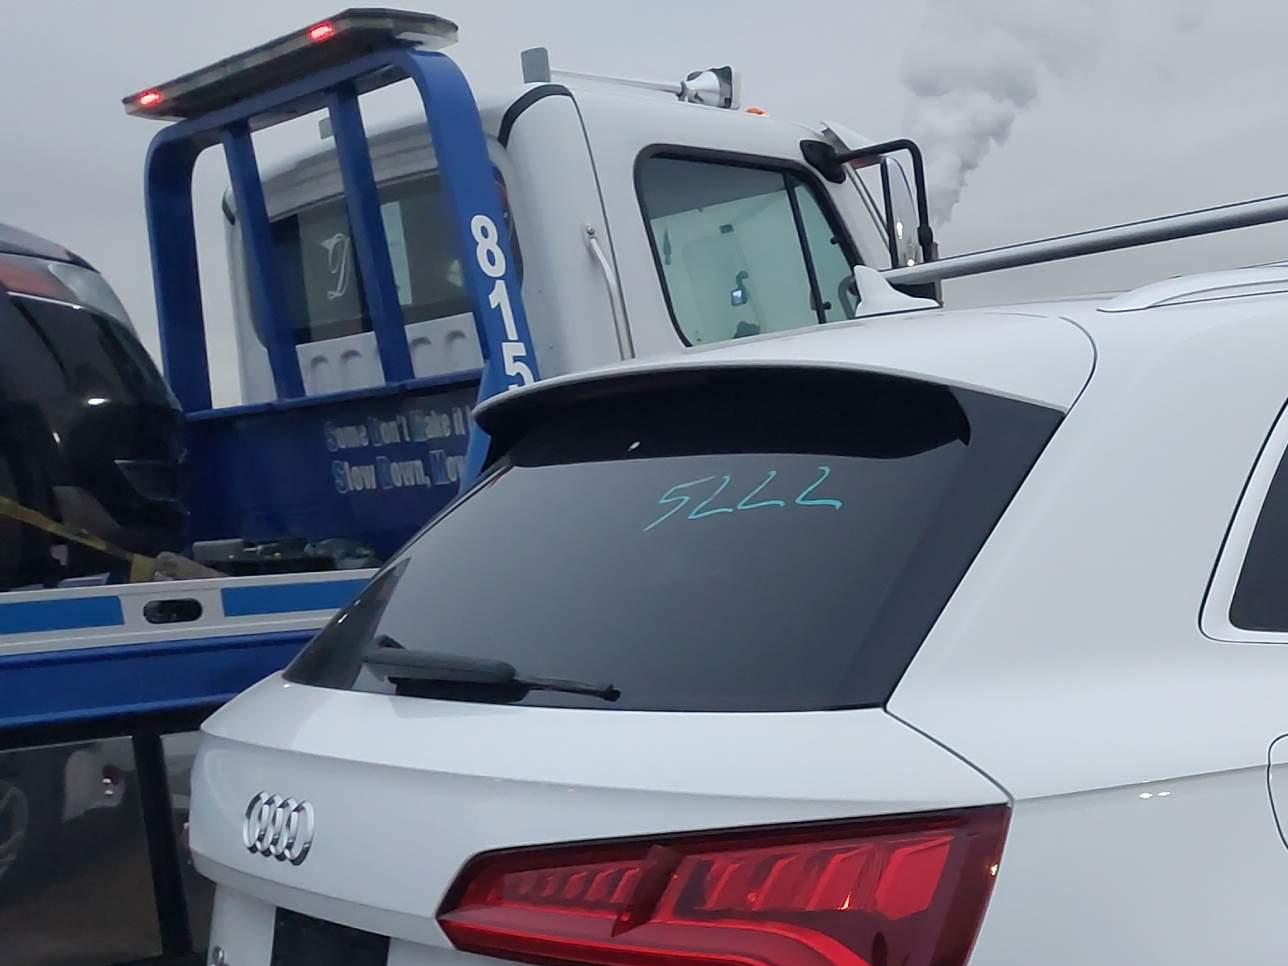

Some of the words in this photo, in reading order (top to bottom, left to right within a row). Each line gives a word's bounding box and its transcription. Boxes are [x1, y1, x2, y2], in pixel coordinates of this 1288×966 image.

[470, 214, 535, 390] 815
[333, 460, 377, 494] Slow
[376, 455, 431, 489] Down,
[643, 466, 842, 531] 5222
